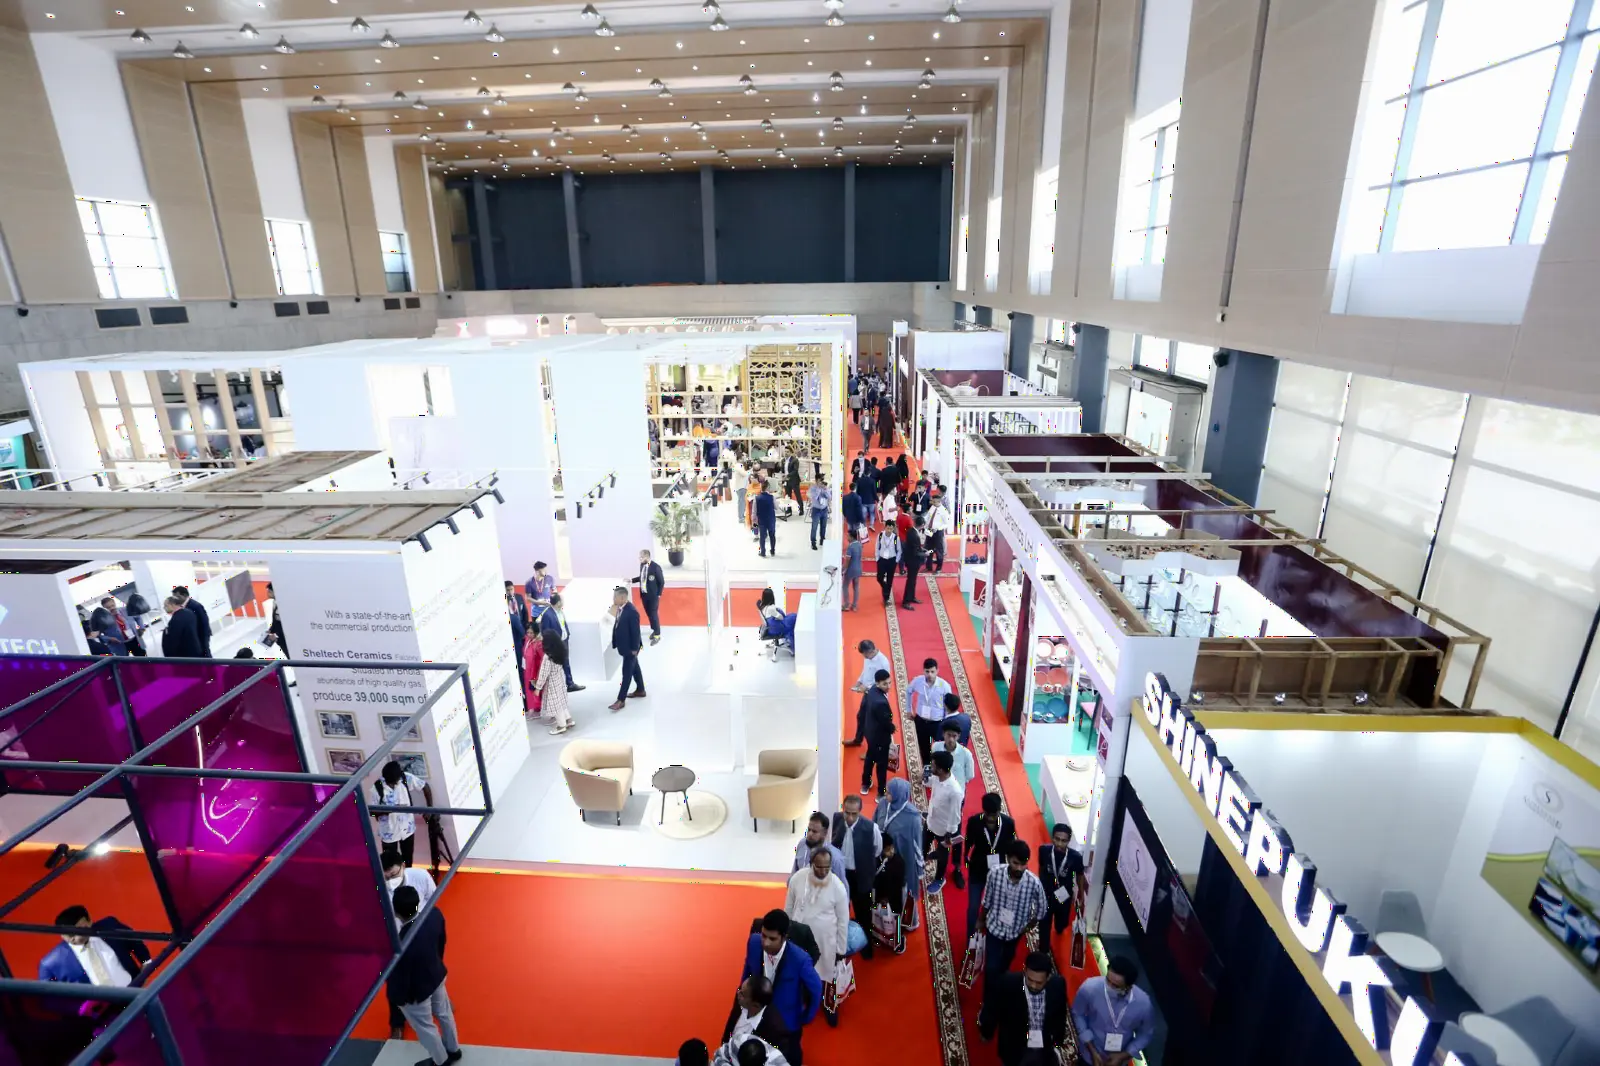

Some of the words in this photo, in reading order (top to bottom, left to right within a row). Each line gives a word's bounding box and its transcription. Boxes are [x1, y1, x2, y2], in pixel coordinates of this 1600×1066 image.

[324, 609, 344, 619] With
[345, 612, 351, 620] a
[352, 611, 412, 621] state-of-the-art
[310, 622, 323, 630] the
[325, 622, 369, 632] commercial
[371, 624, 414, 633] production
[302, 648, 345, 659] Sheltech
[346, 650, 393, 660] Ceramics
[317, 677, 356, 686] abundance
[357, 678, 364, 686] of
[365, 679, 381, 688] high
[382, 680, 407, 689] quality
[312, 691, 352, 703] produce
[354, 691, 389, 704] 39,000
[391, 695, 415, 706] sqm
[417, 693, 427, 704] of
